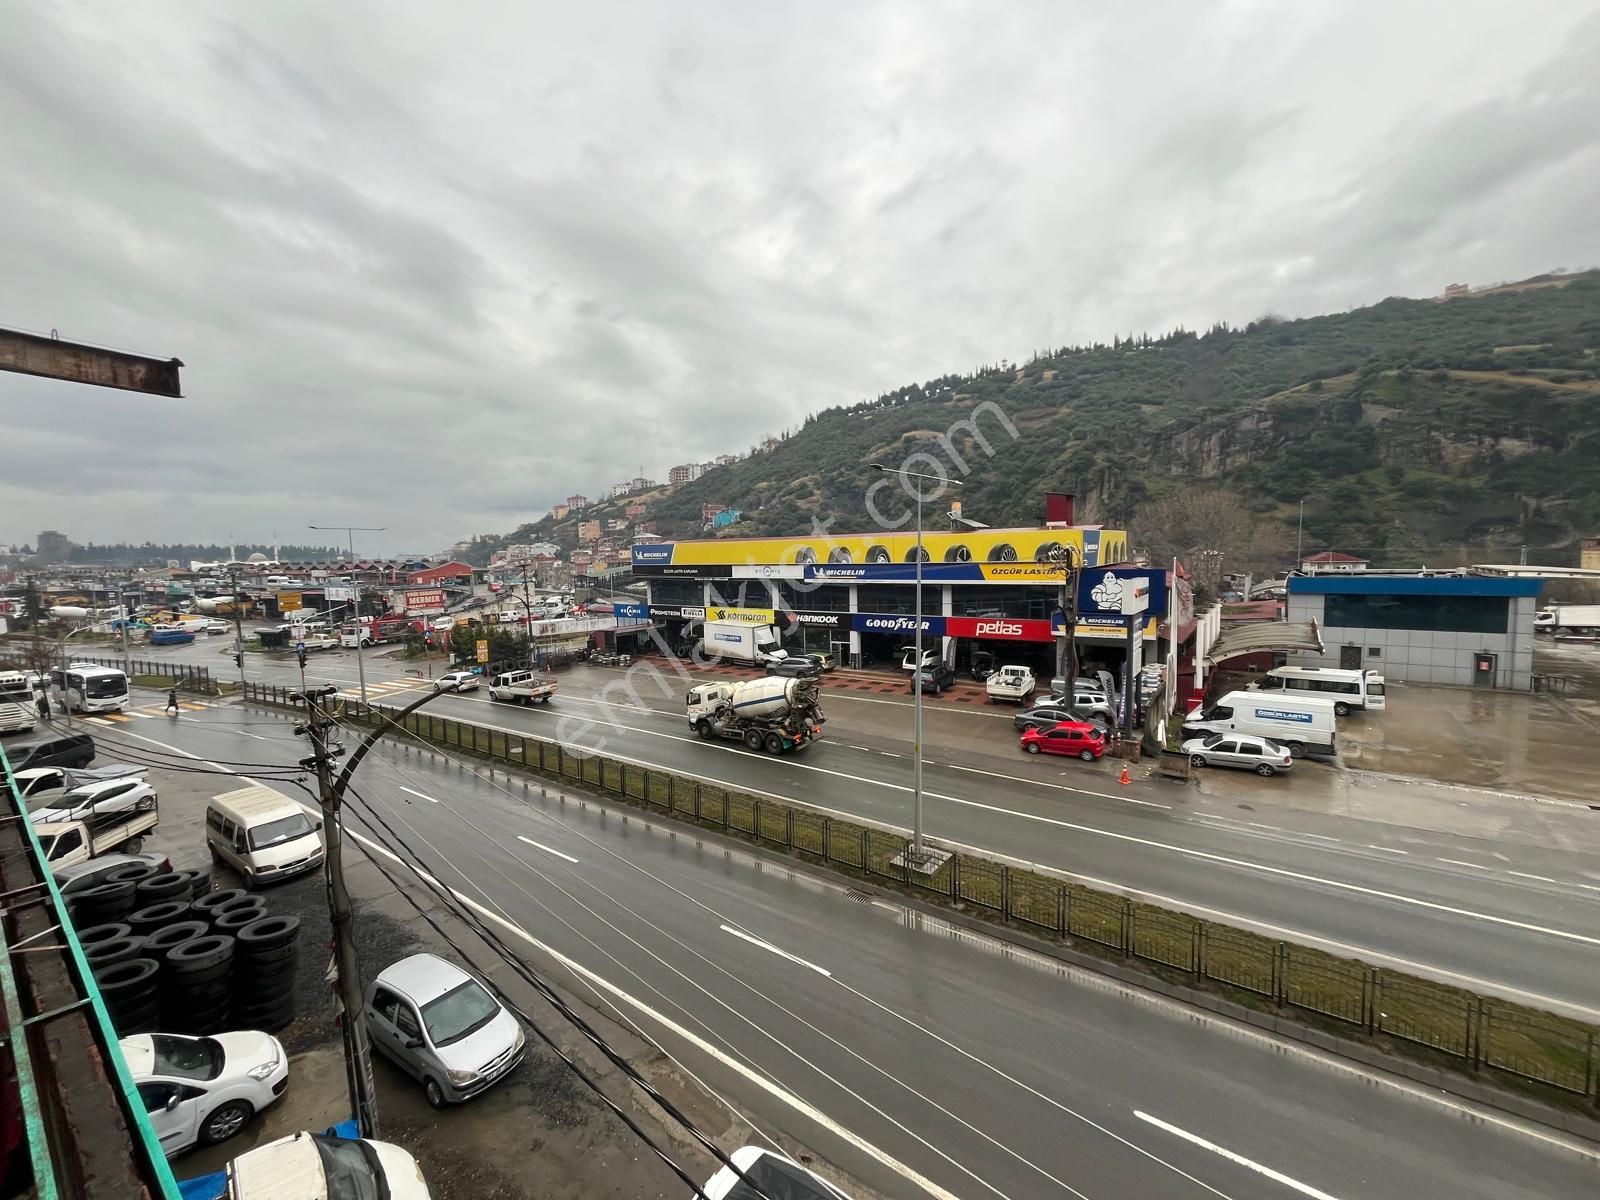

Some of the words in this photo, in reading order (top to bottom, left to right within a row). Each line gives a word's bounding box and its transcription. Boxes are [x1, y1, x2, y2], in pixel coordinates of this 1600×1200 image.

[991, 567, 1022, 575] ÖZGÜR
[727, 611, 767, 621] kormoran
[975, 621, 1023, 636] petlas
[1257, 709, 1283, 717] ÖZGÜR
